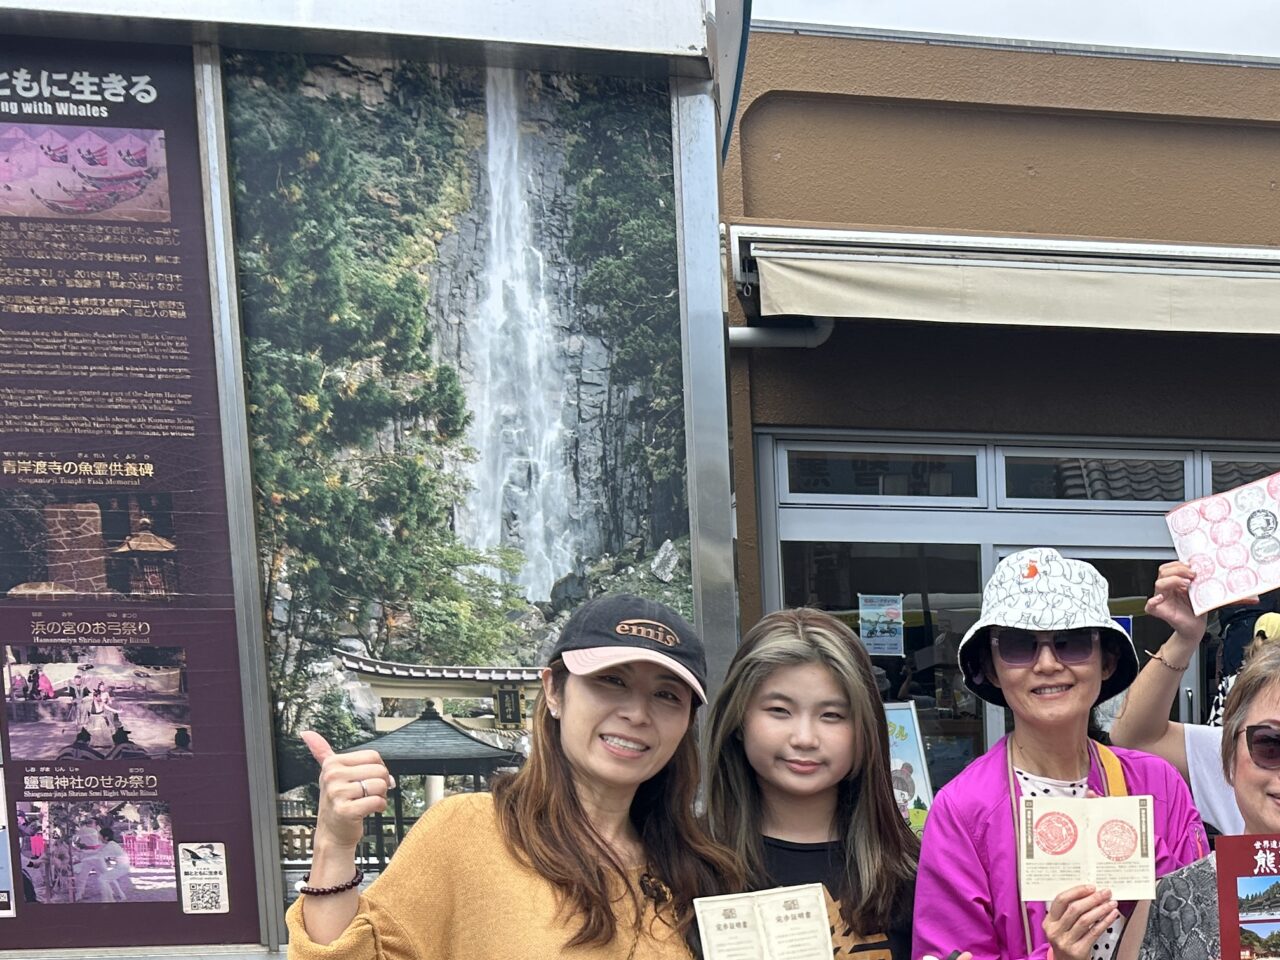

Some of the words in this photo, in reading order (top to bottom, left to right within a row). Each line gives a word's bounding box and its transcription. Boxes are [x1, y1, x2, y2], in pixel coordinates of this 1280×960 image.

[0, 102, 18, 114] ng
[22, 102, 52, 114] with
[56, 102, 108, 118] Whales
[2, 460, 154, 477] 青岸渡寺の魚霊供養碑
[60, 477, 85, 486] Temple
[30, 620, 150, 635] 浜の宮のお弓祭り
[616, 622, 676, 646] emis
